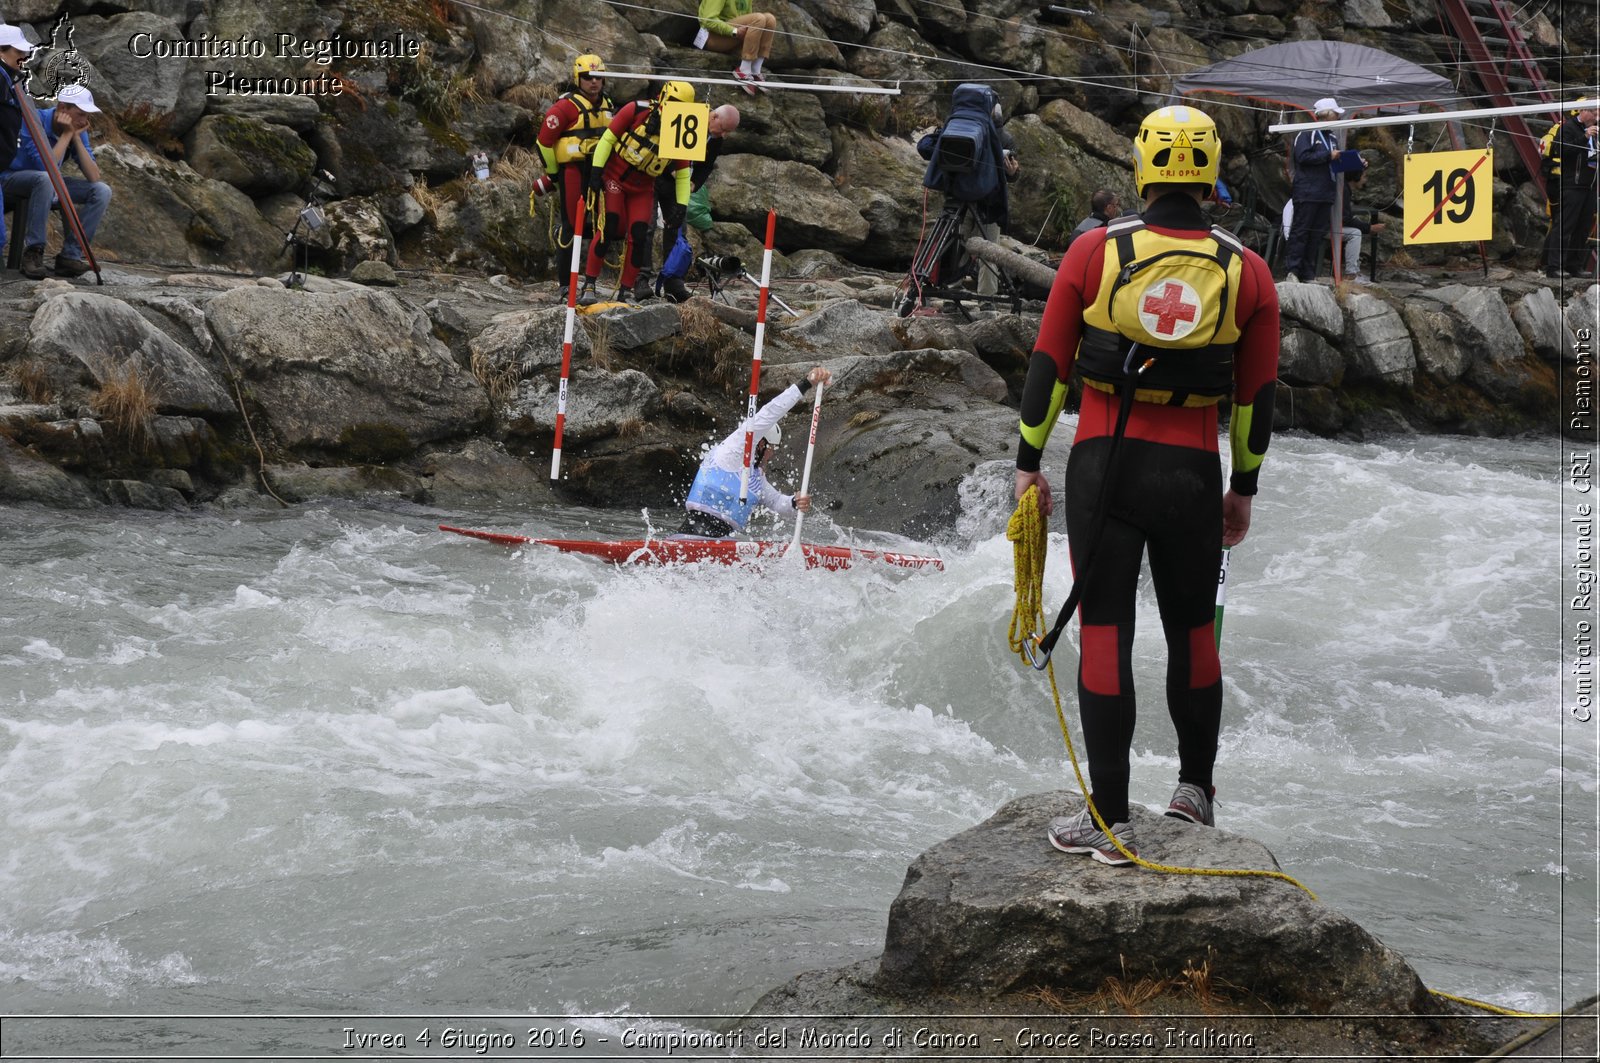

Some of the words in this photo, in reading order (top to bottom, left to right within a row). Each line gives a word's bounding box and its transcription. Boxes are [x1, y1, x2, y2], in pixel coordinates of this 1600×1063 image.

[670, 113, 698, 150] 18
[1177, 152, 1186, 162] 9
[1422, 167, 1476, 225] 19
